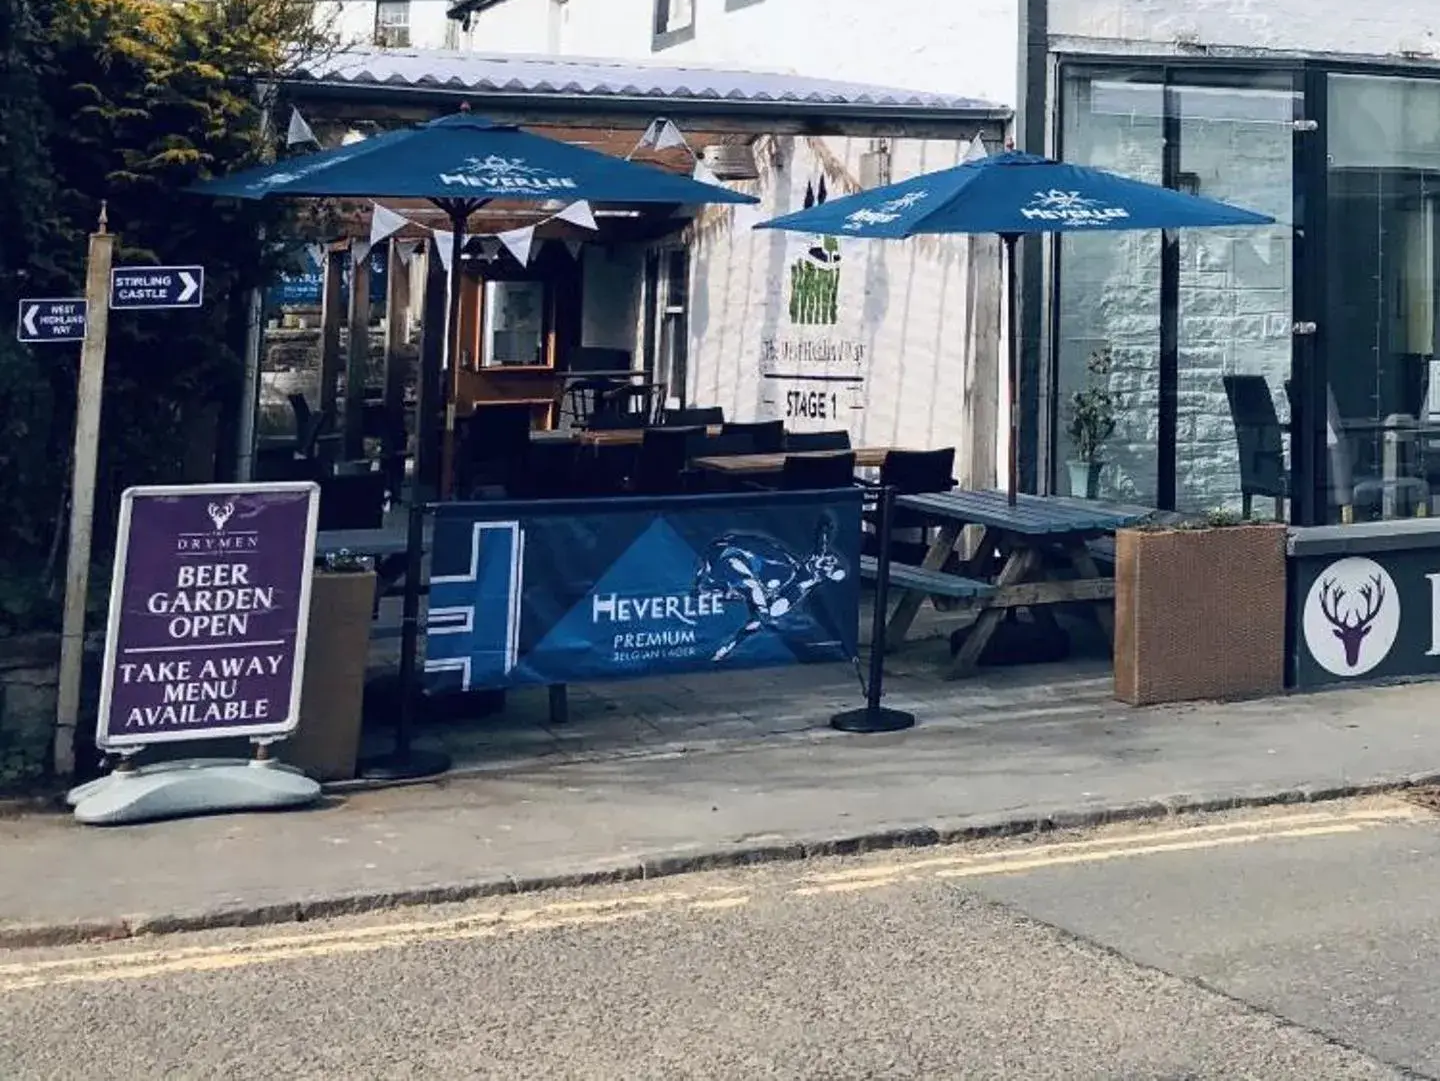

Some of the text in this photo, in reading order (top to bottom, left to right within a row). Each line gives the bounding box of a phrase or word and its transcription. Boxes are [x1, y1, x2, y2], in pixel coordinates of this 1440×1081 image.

[439, 173, 577, 190] HEVERLEE
[115, 276, 172, 287] STIRLING
[119, 289, 168, 299] CASTLE
[51, 304, 75, 313] WEST
[40, 315, 84, 324] HIGHLAND
[53, 326, 71, 334] WAY
[786, 390, 836, 420] STAGE 1
[177, 536, 258, 550] DRYMEN
[178, 563, 249, 587] BEER
[148, 587, 273, 613] GARDEN
[593, 592, 725, 624] HEVERLEE
[169, 613, 248, 638] OPEN
[614, 630, 695, 648] PREMIUM
[120, 655, 283, 683] TAKE AWAY
[164, 680, 237, 703] MENU
[126, 699, 268, 727] AVAILABLE
